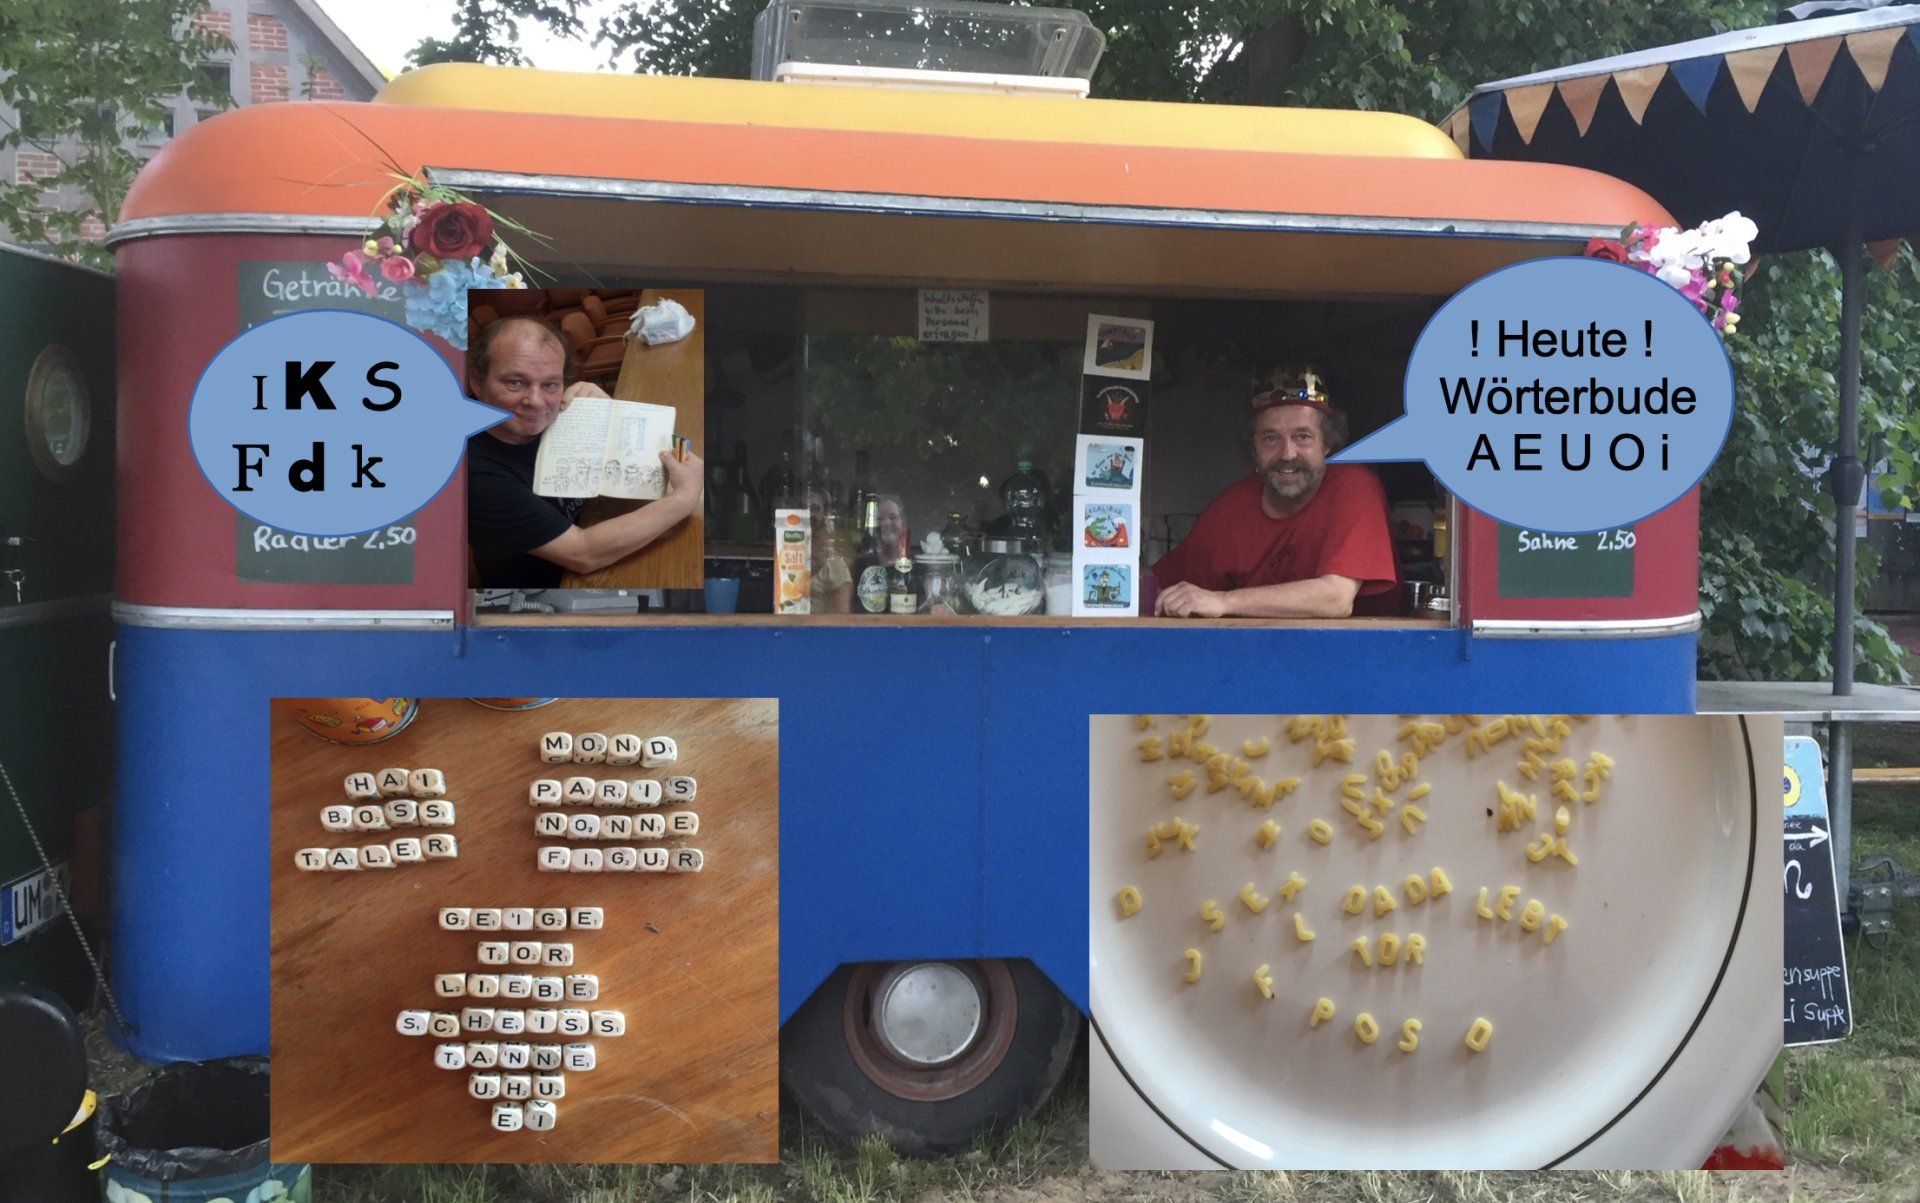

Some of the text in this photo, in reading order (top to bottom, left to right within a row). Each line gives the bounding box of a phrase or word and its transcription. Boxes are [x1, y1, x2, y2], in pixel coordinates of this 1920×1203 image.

[1517, 529, 1637, 553] Sahne 2,50
[544, 735, 668, 757] MOND
[352, 771, 431, 793] HAI
[536, 778, 691, 799] PARIS
[327, 802, 443, 825] BOSS
[542, 815, 691, 835] NONNE
[300, 837, 445, 867] TALER
[546, 849, 695, 869] FIGUR
[444, 910, 595, 928] GEIGE
[484, 945, 567, 964] TOR
[441, 978, 590, 999] LIEBE
[402, 1013, 619, 1035] SCHEISS
[443, 1049, 589, 1068] TANNE
[473, 1081, 558, 1098] UHU
[496, 1112, 546, 1130] EI
